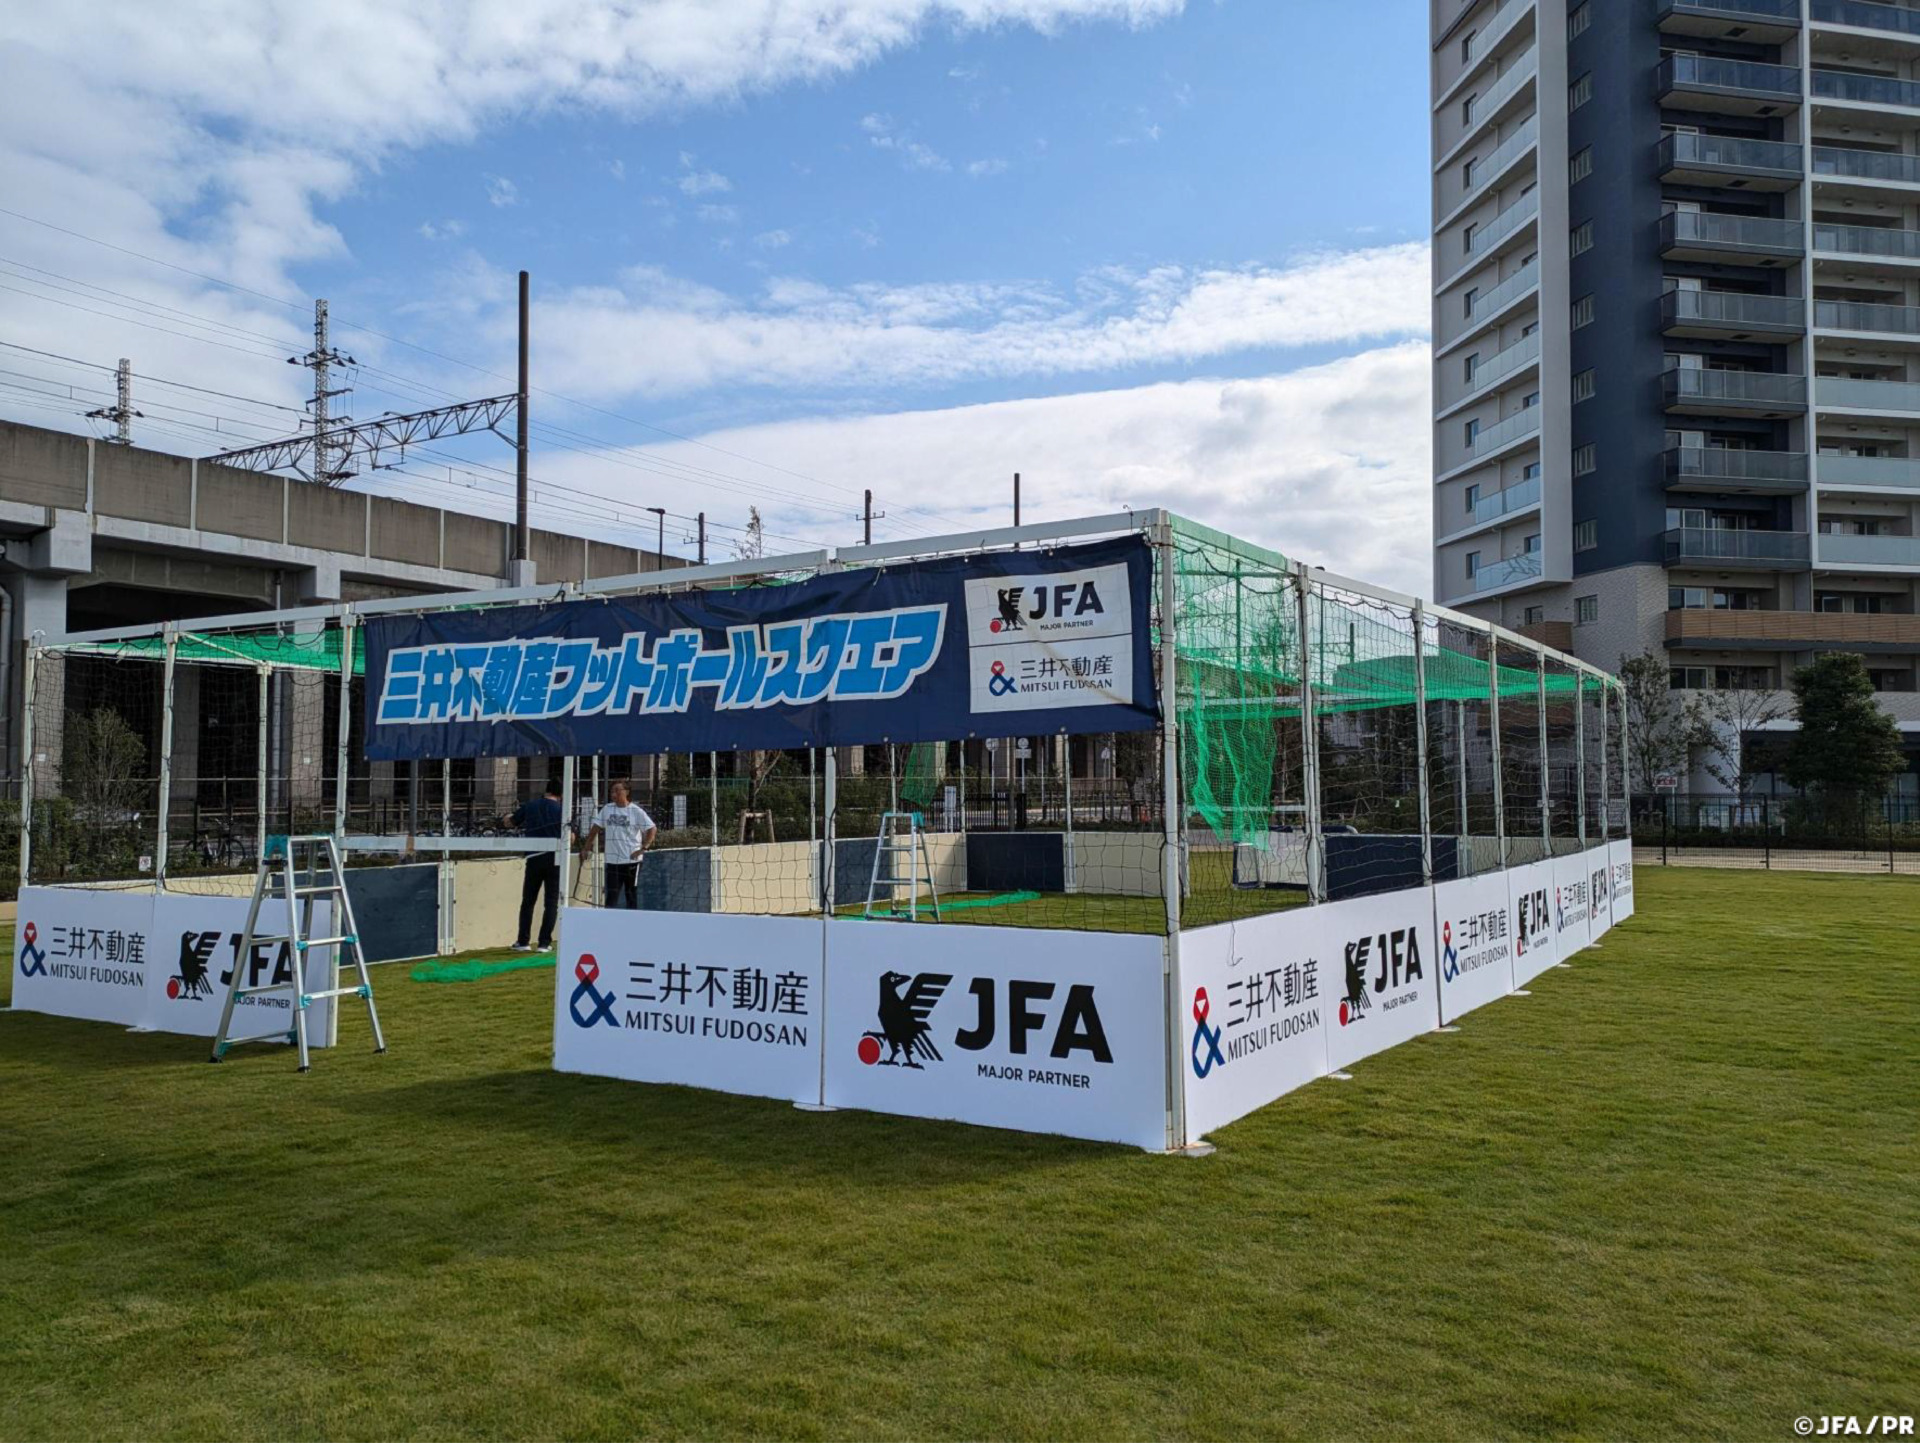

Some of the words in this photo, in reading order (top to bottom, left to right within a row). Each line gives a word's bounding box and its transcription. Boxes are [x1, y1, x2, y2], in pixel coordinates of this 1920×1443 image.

[1029, 581, 1104, 620] JFA
[1040, 622, 1062, 631] MAJOR
[1063, 620, 1093, 629] PARTNER
[376, 603, 949, 725] 三井不動産フットボールスクエア
[1020, 654, 1113, 680] 三井不動産
[1020, 680, 1059, 693] MITSUI
[1063, 678, 1113, 691] FUDOSAN
[1459, 908, 1507, 950] 三井不動産
[1530, 888, 1550, 936] JFA
[50, 926, 146, 965] 三井不動産
[220, 933, 293, 988] JFA
[1375, 926, 1423, 994] JFA
[1460, 952, 1481, 973] MITSUI
[50, 963, 87, 981] MITSUI
[90, 966, 145, 988] FUDOSAN
[626, 961, 809, 1016] 三井不動産
[1227, 958, 1319, 1028] 三井不動産
[257, 996, 291, 1009] PARTNER
[955, 977, 1114, 1064] JFA
[625, 1010, 695, 1036] MITSUI
[702, 1017, 808, 1048] FUDOSAN
[1227, 1028, 1267, 1063] MITSUI
[1270, 1007, 1320, 1045] FUDOSAN
[977, 1063, 1023, 1081] MAJOR
[1028, 1069, 1090, 1089] PARTNER
